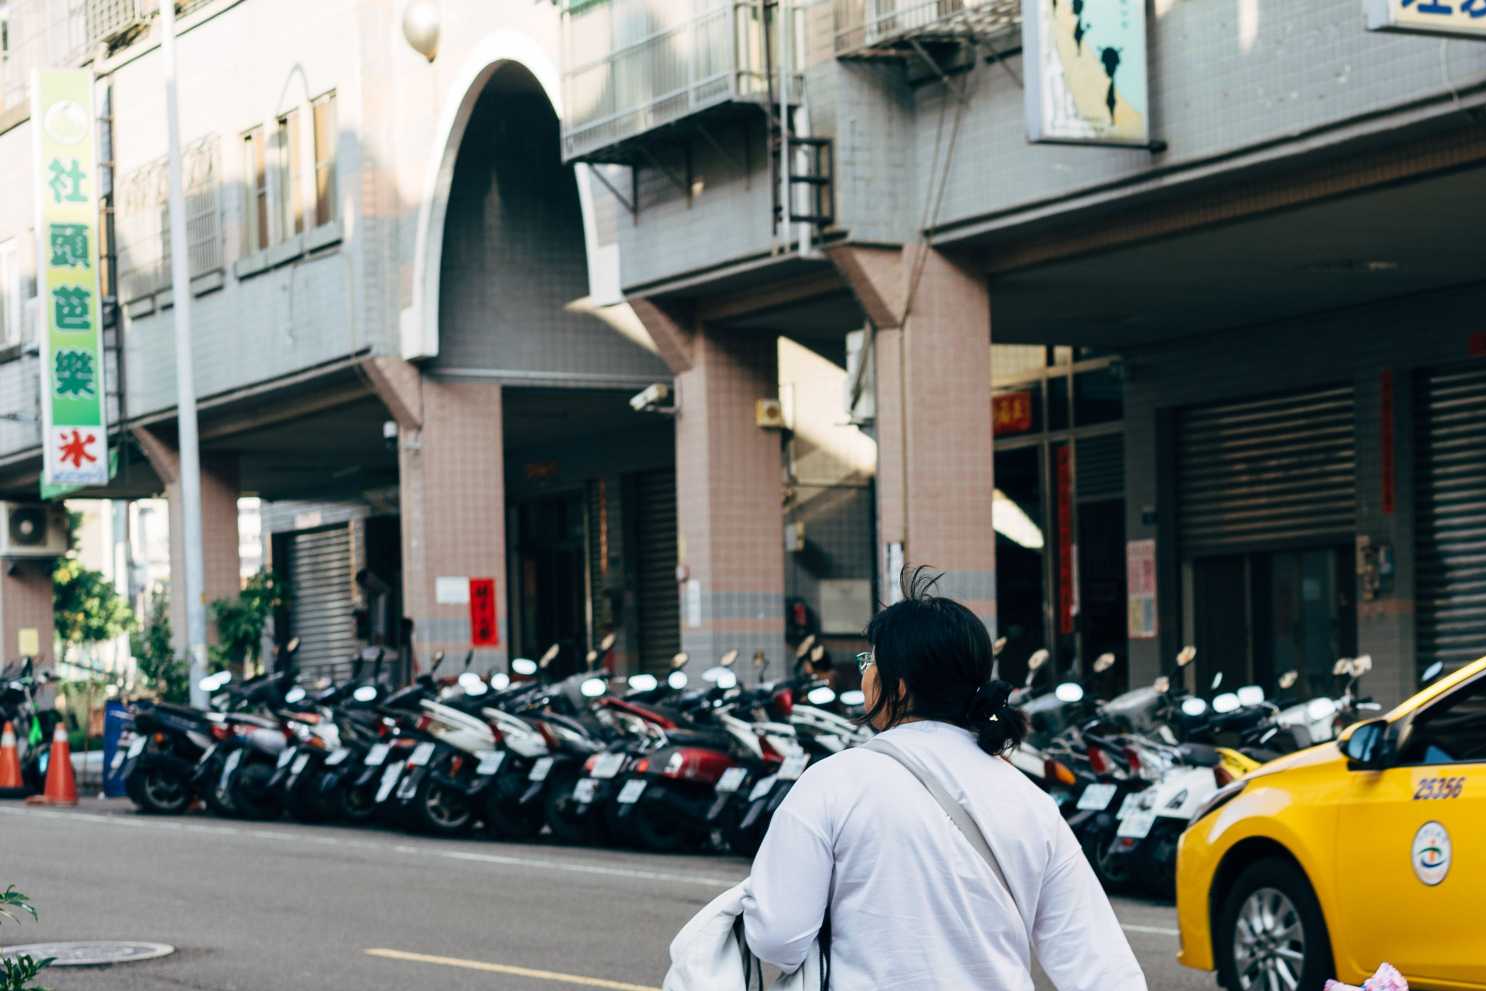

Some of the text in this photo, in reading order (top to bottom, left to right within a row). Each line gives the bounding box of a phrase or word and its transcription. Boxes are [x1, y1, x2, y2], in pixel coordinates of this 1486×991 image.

[47, 157, 96, 396] 社頭芭樂
[1413, 776, 1466, 800] 25356
